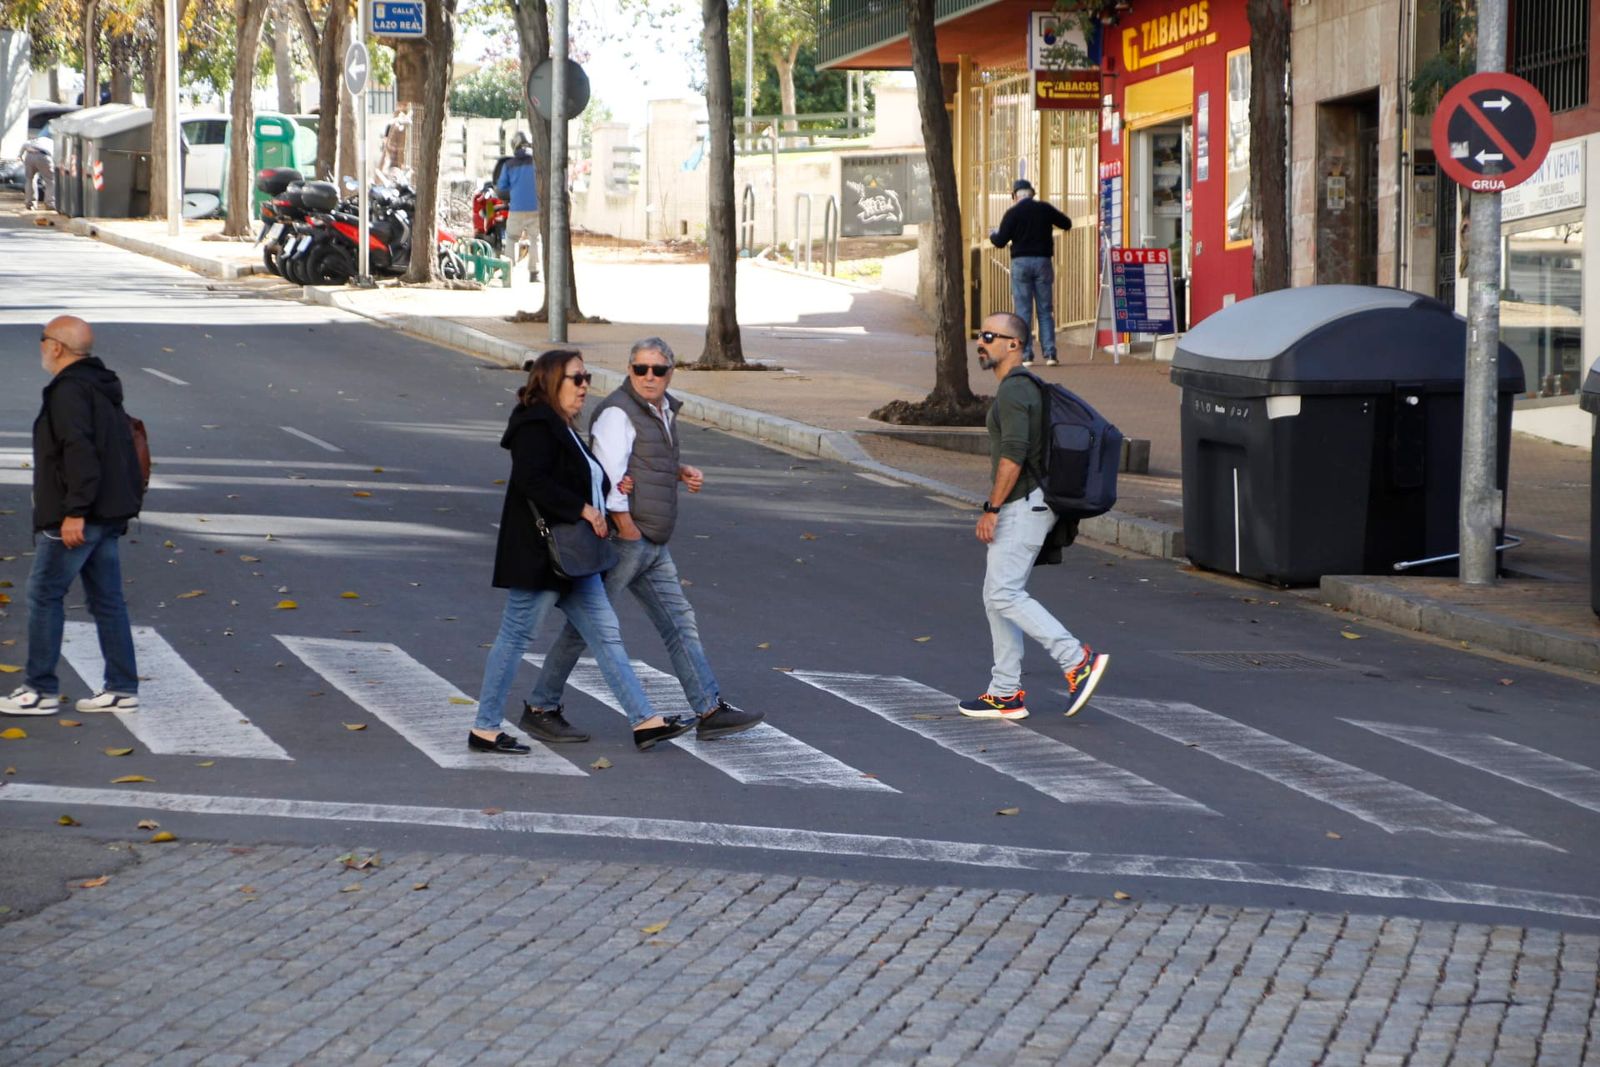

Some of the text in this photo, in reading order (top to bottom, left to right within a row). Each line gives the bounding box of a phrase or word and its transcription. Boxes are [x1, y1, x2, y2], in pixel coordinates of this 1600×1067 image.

[392, 7, 414, 15] CALLE
[374, 20, 422, 30] LAZO REAL
[1141, 0, 1209, 52] TABACOS
[1546, 159, 1552, 182] Y
[1554, 150, 1580, 178] VENTA
[1471, 180, 1506, 190] GRUA
[1112, 250, 1167, 263] BOTES
